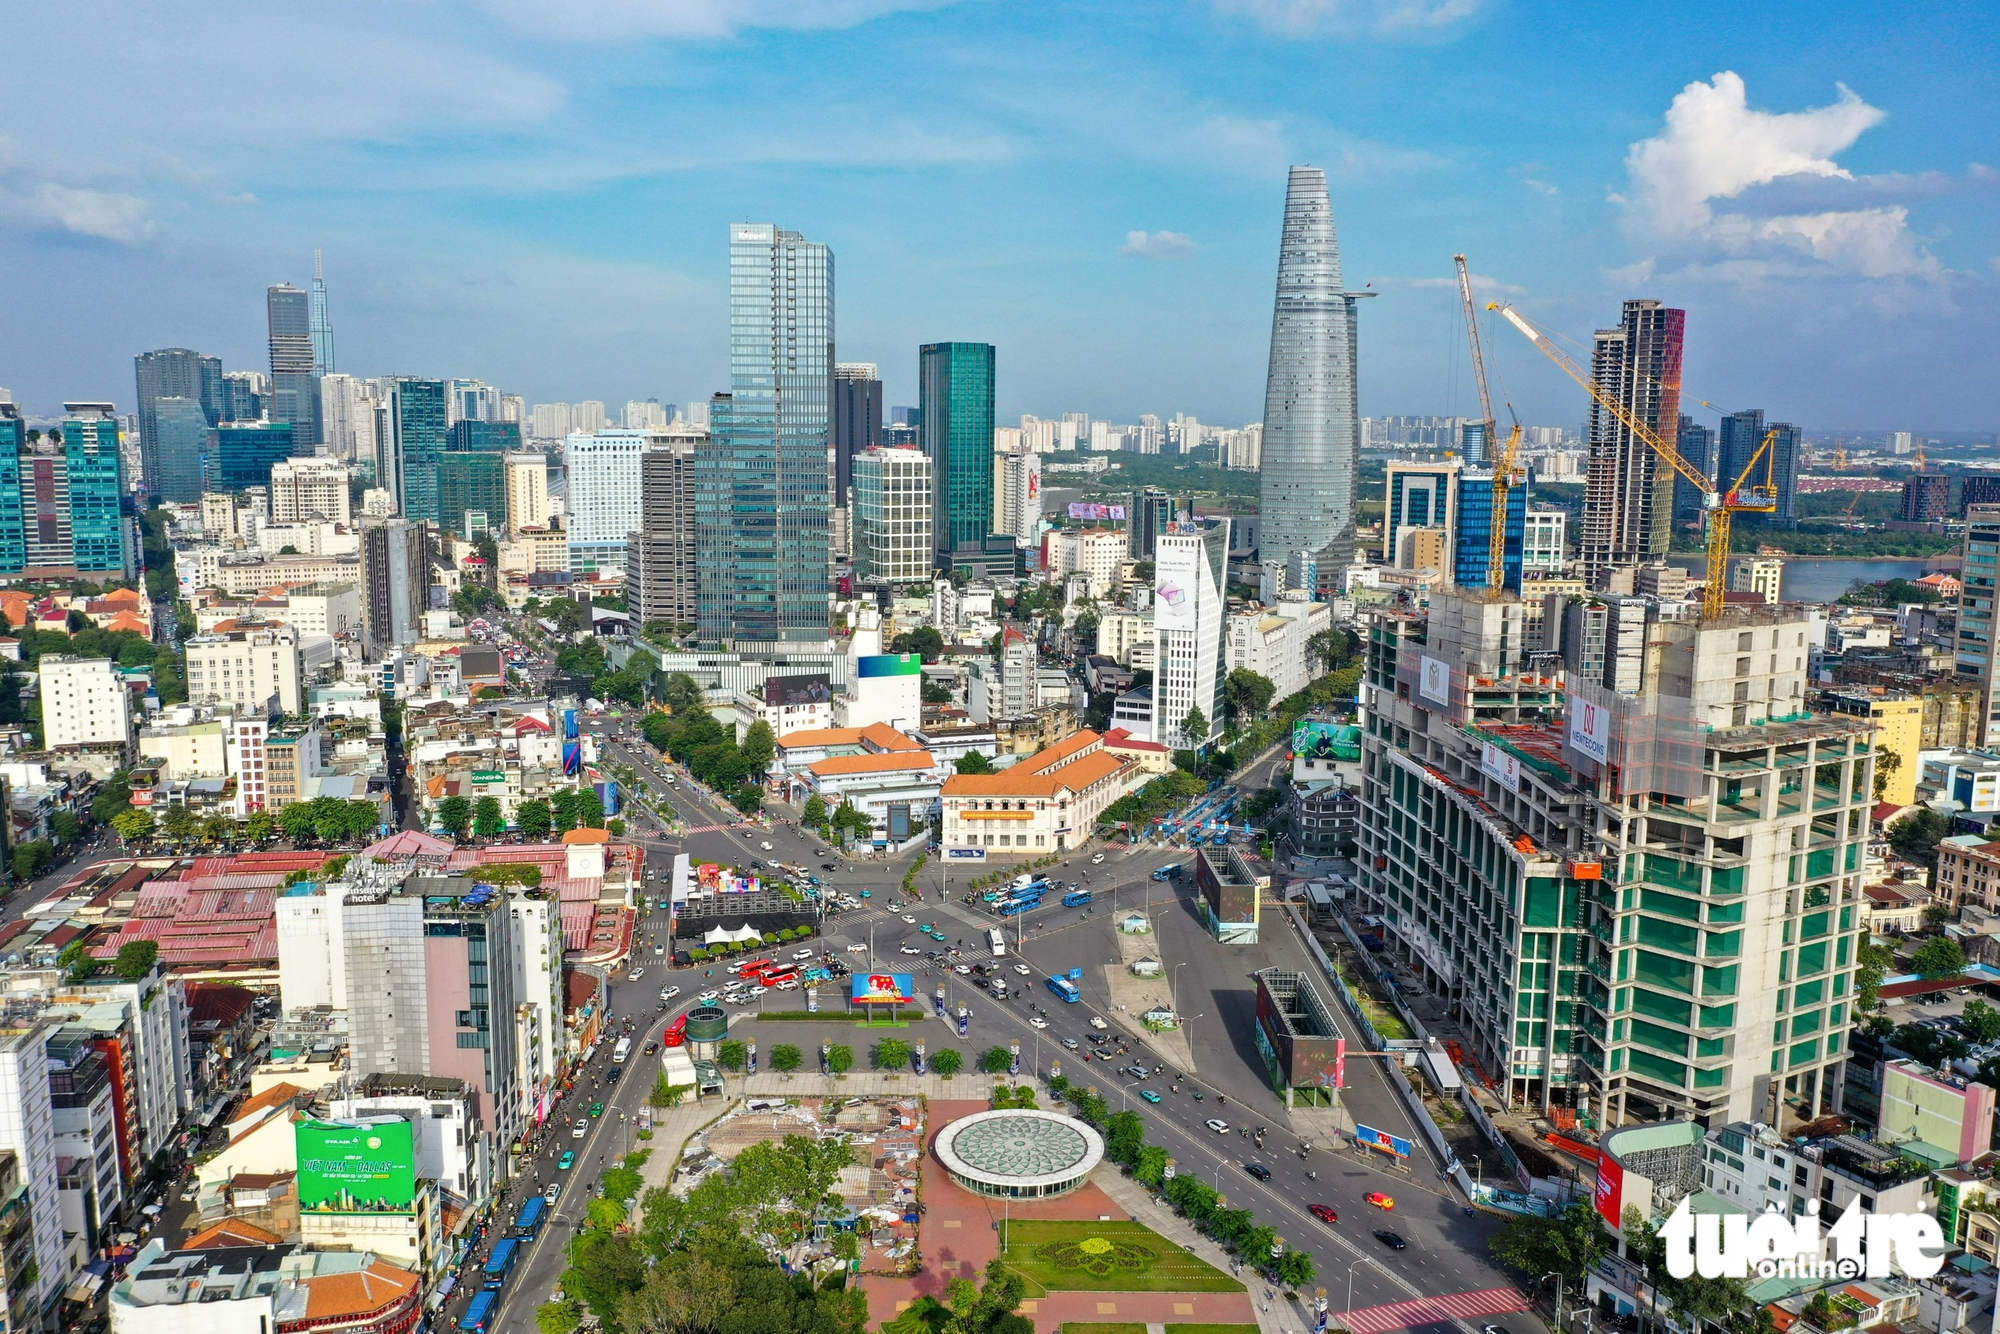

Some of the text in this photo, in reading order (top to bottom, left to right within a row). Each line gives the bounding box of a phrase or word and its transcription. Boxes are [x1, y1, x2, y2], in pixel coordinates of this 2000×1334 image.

[738, 231, 767, 240] Keppel
[1179, 523, 1195, 533] MB
[1572, 730, 1605, 755] NEWTECONS
[303, 1159, 392, 1173] VIỆT NAM DALLAS
